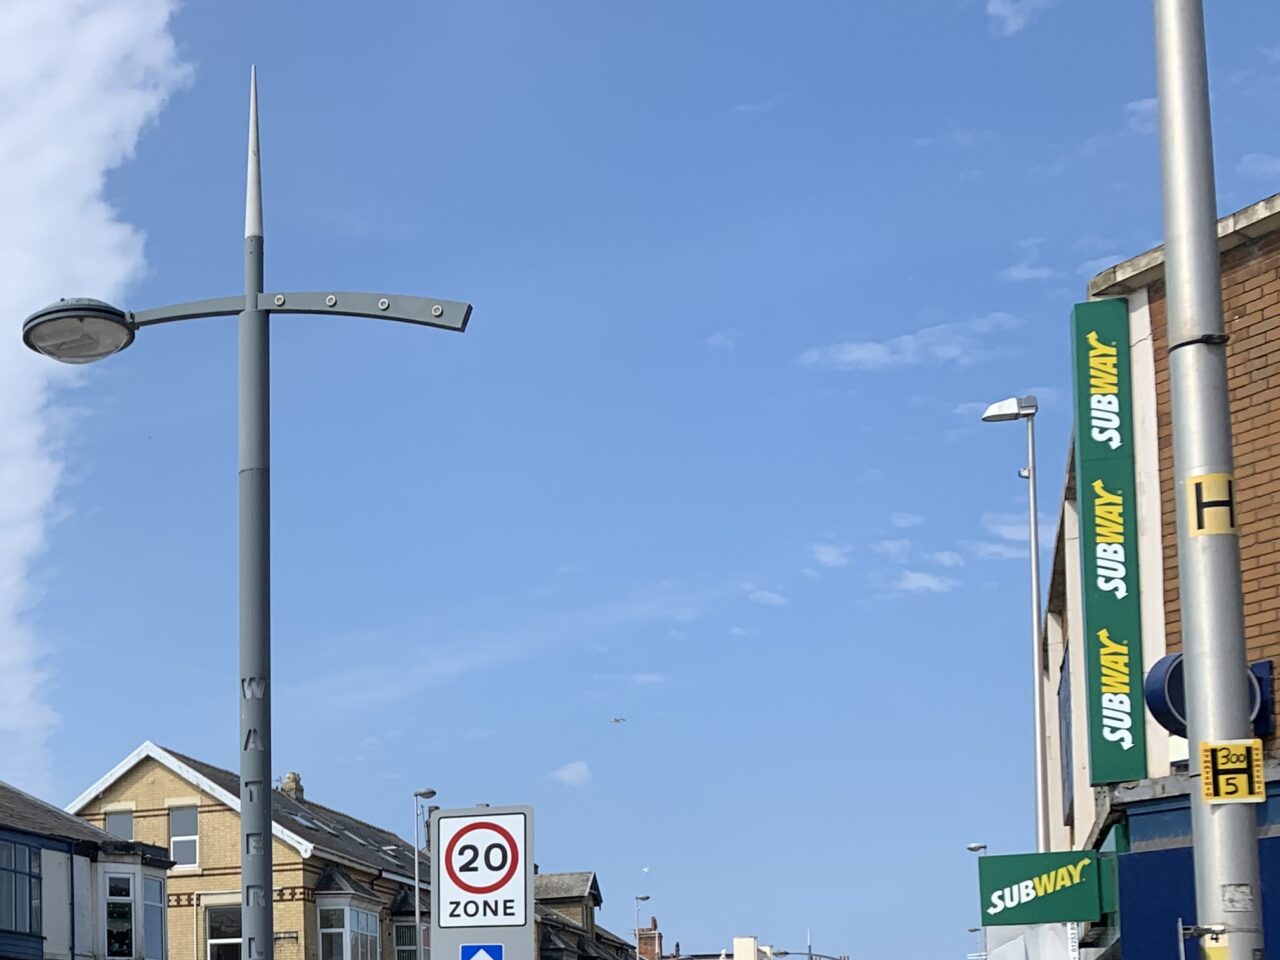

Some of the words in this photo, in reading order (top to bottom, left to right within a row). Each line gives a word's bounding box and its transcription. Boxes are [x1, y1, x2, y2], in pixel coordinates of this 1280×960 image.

[1086, 331, 1123, 450] SUBWAY
[1194, 479, 1235, 531] H
[1091, 479, 1128, 600] SUBWAY
[1097, 629, 1134, 751] SUBWAY
[1211, 746, 1255, 797] H
[1217, 747, 1247, 766] 300
[1224, 777, 1239, 795] 5
[458, 843, 508, 872] 20
[449, 899, 515, 918] ZONE
[987, 857, 1092, 915] SUBWAY
